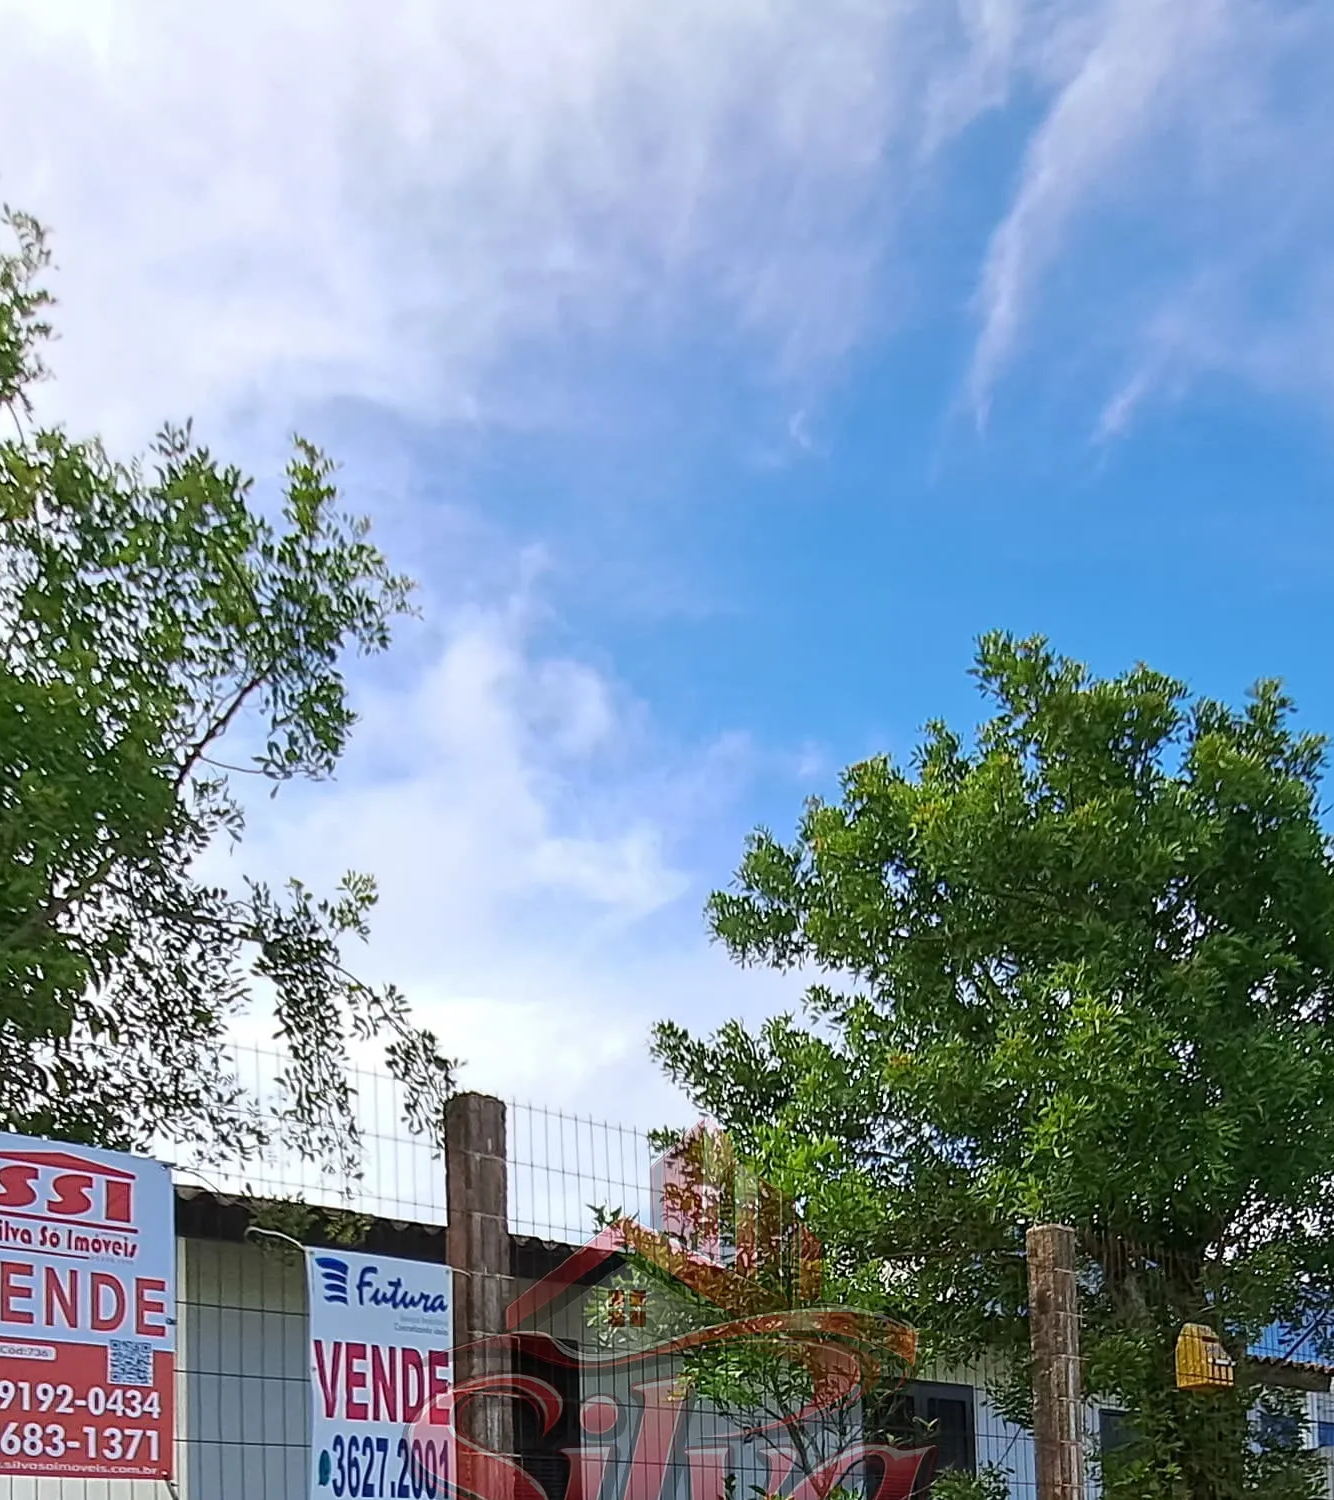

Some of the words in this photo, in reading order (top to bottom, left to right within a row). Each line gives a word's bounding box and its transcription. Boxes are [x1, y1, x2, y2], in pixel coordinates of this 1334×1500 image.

[355, 1266, 448, 1314] Futura
[313, 1339, 451, 1426] VENDE
[332, 1434, 449, 1500] 3627.2001
